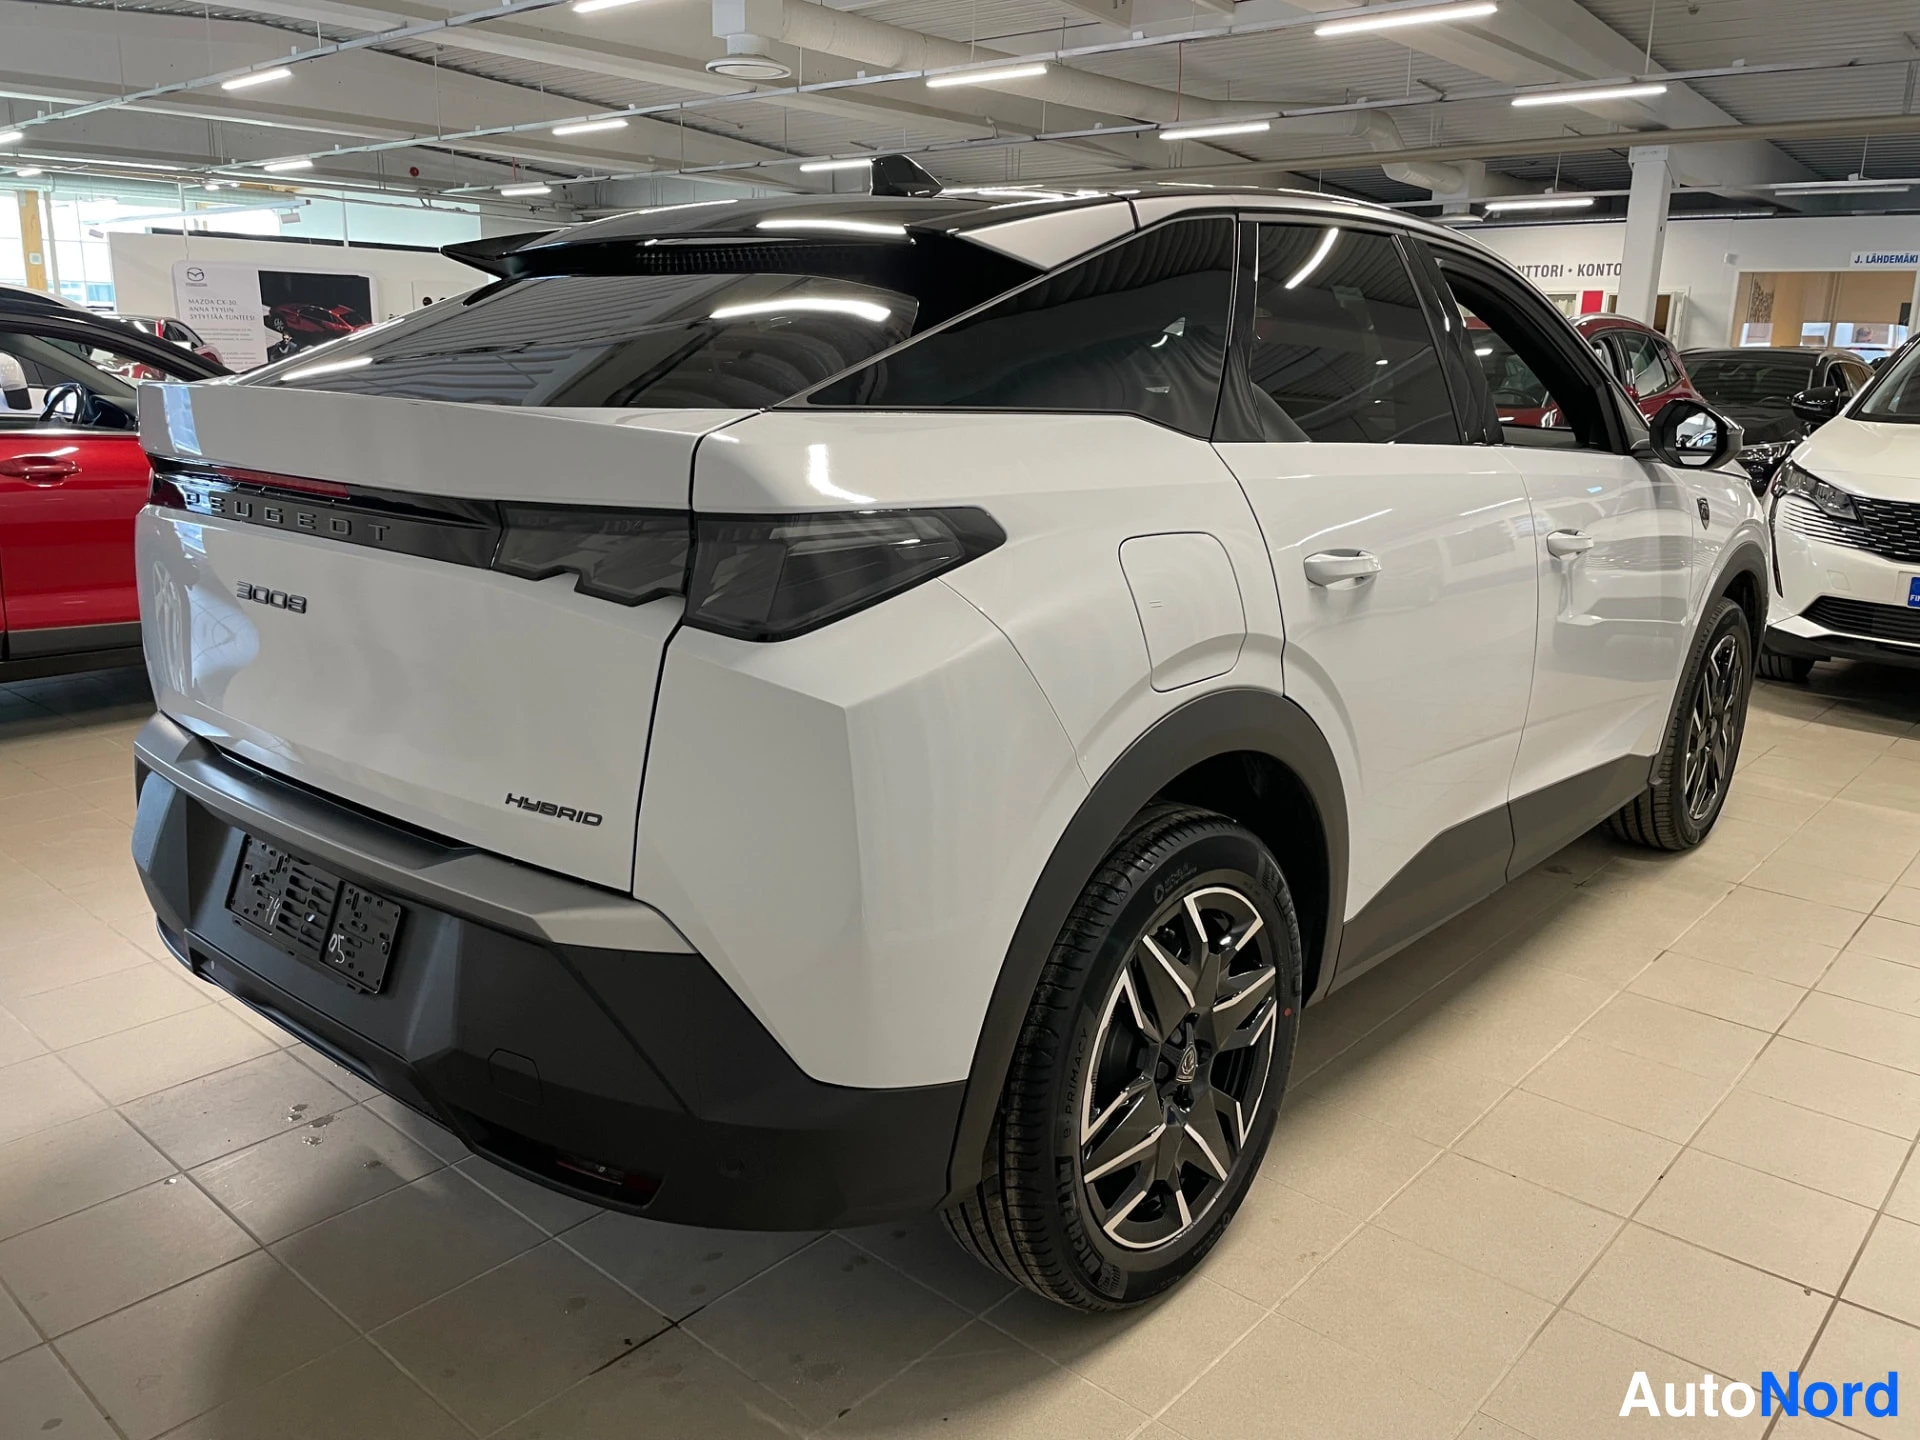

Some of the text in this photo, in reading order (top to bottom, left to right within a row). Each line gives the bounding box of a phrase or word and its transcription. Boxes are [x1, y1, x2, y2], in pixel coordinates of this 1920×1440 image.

[1854, 252, 1919, 264] J. LÄHDEMÄKI
[188, 298, 215, 306] MAZDA
[186, 491, 391, 542] PEUGEOT
[236, 580, 308, 615] 3008
[505, 793, 603, 827] HYBRID
